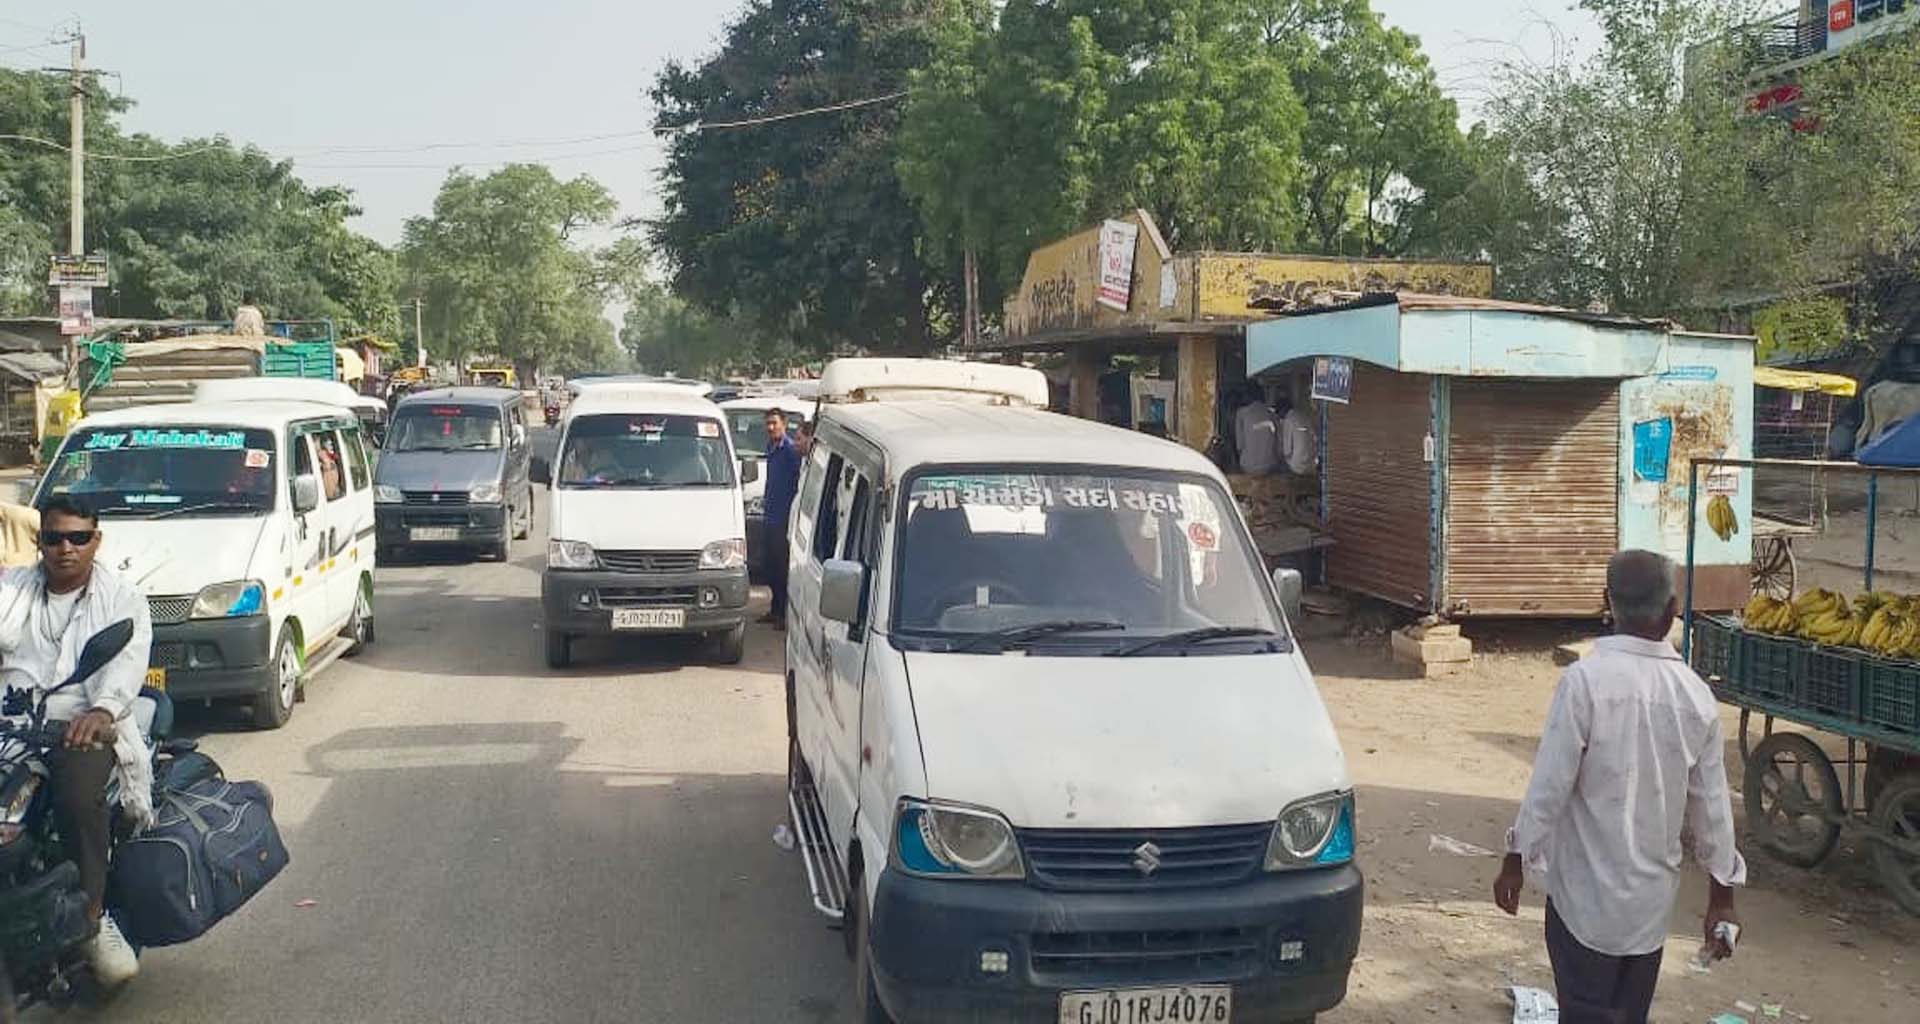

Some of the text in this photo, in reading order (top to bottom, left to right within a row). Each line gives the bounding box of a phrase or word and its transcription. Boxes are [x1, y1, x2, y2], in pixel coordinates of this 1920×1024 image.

[84, 429, 246, 449] Jay Mahakali
[1080, 995, 1226, 1024] GJ01RJ4076
